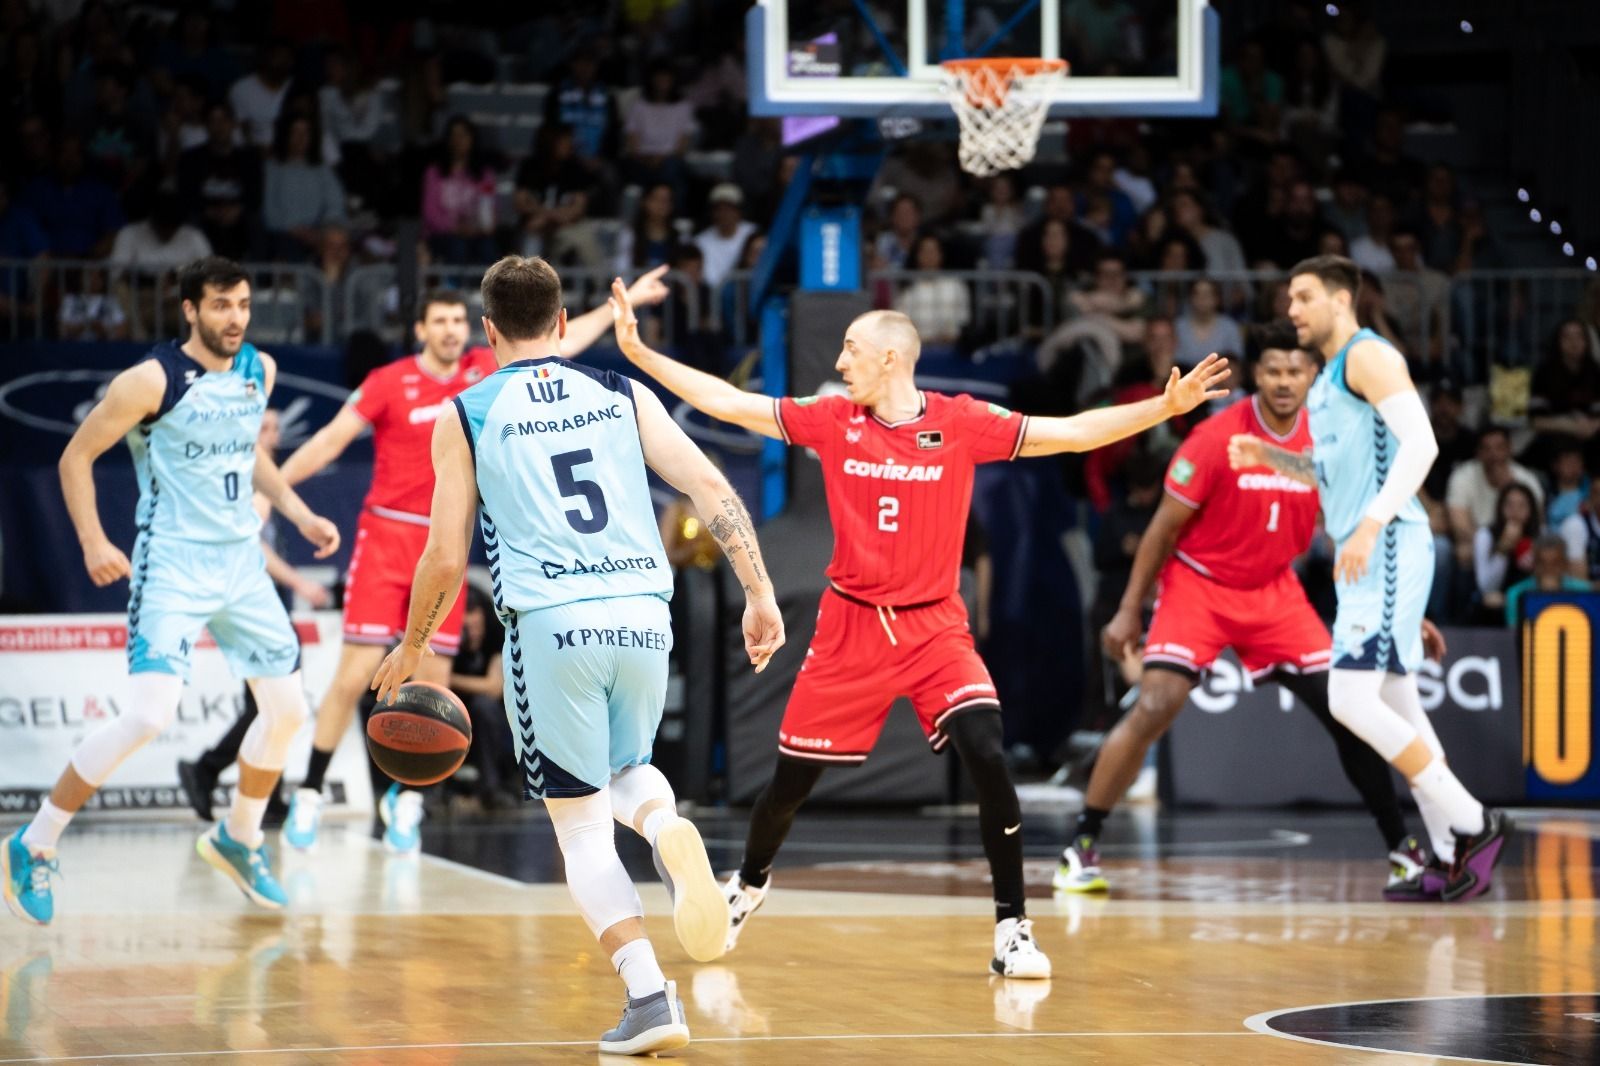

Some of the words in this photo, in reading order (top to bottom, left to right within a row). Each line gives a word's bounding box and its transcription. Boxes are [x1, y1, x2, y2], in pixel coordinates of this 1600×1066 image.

[526, 378, 570, 404] LUZ
[517, 404, 622, 436] MORABANC
[550, 447, 609, 534] 5
[877, 496, 899, 532] 2
[1266, 501, 1280, 531] 1
[572, 555, 658, 575] Andorra
